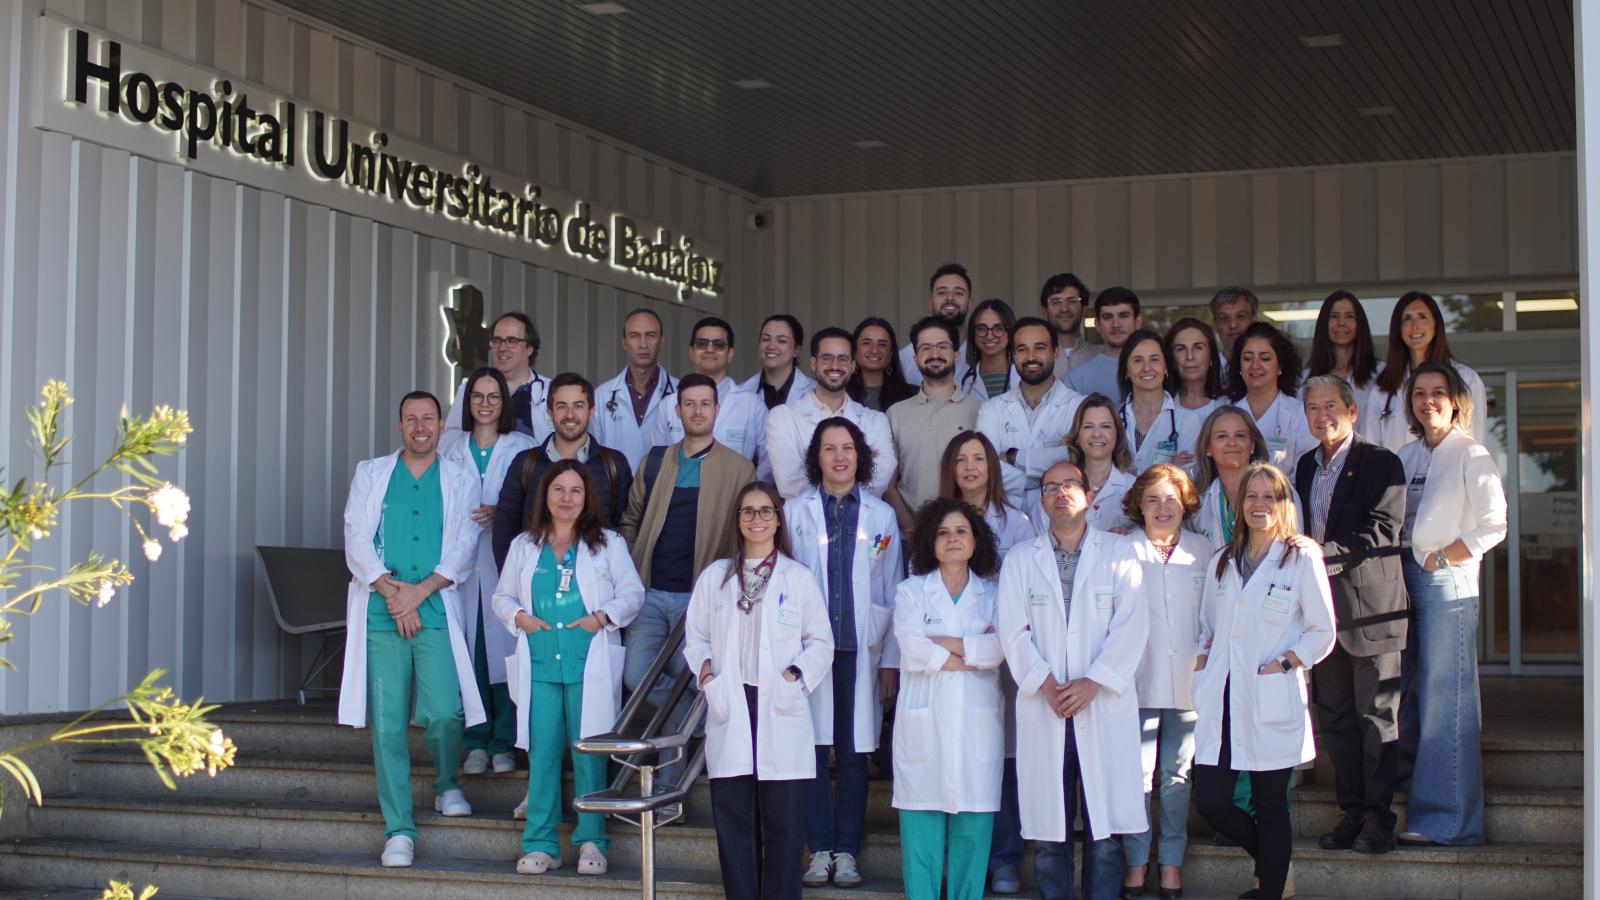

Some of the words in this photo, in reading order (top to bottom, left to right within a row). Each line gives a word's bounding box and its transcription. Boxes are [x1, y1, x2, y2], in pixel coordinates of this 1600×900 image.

[66, 29, 295, 167] Hospital
[304, 110, 562, 247] Universitario
[565, 202, 609, 262] de
[611, 214, 723, 301] Badajoz
